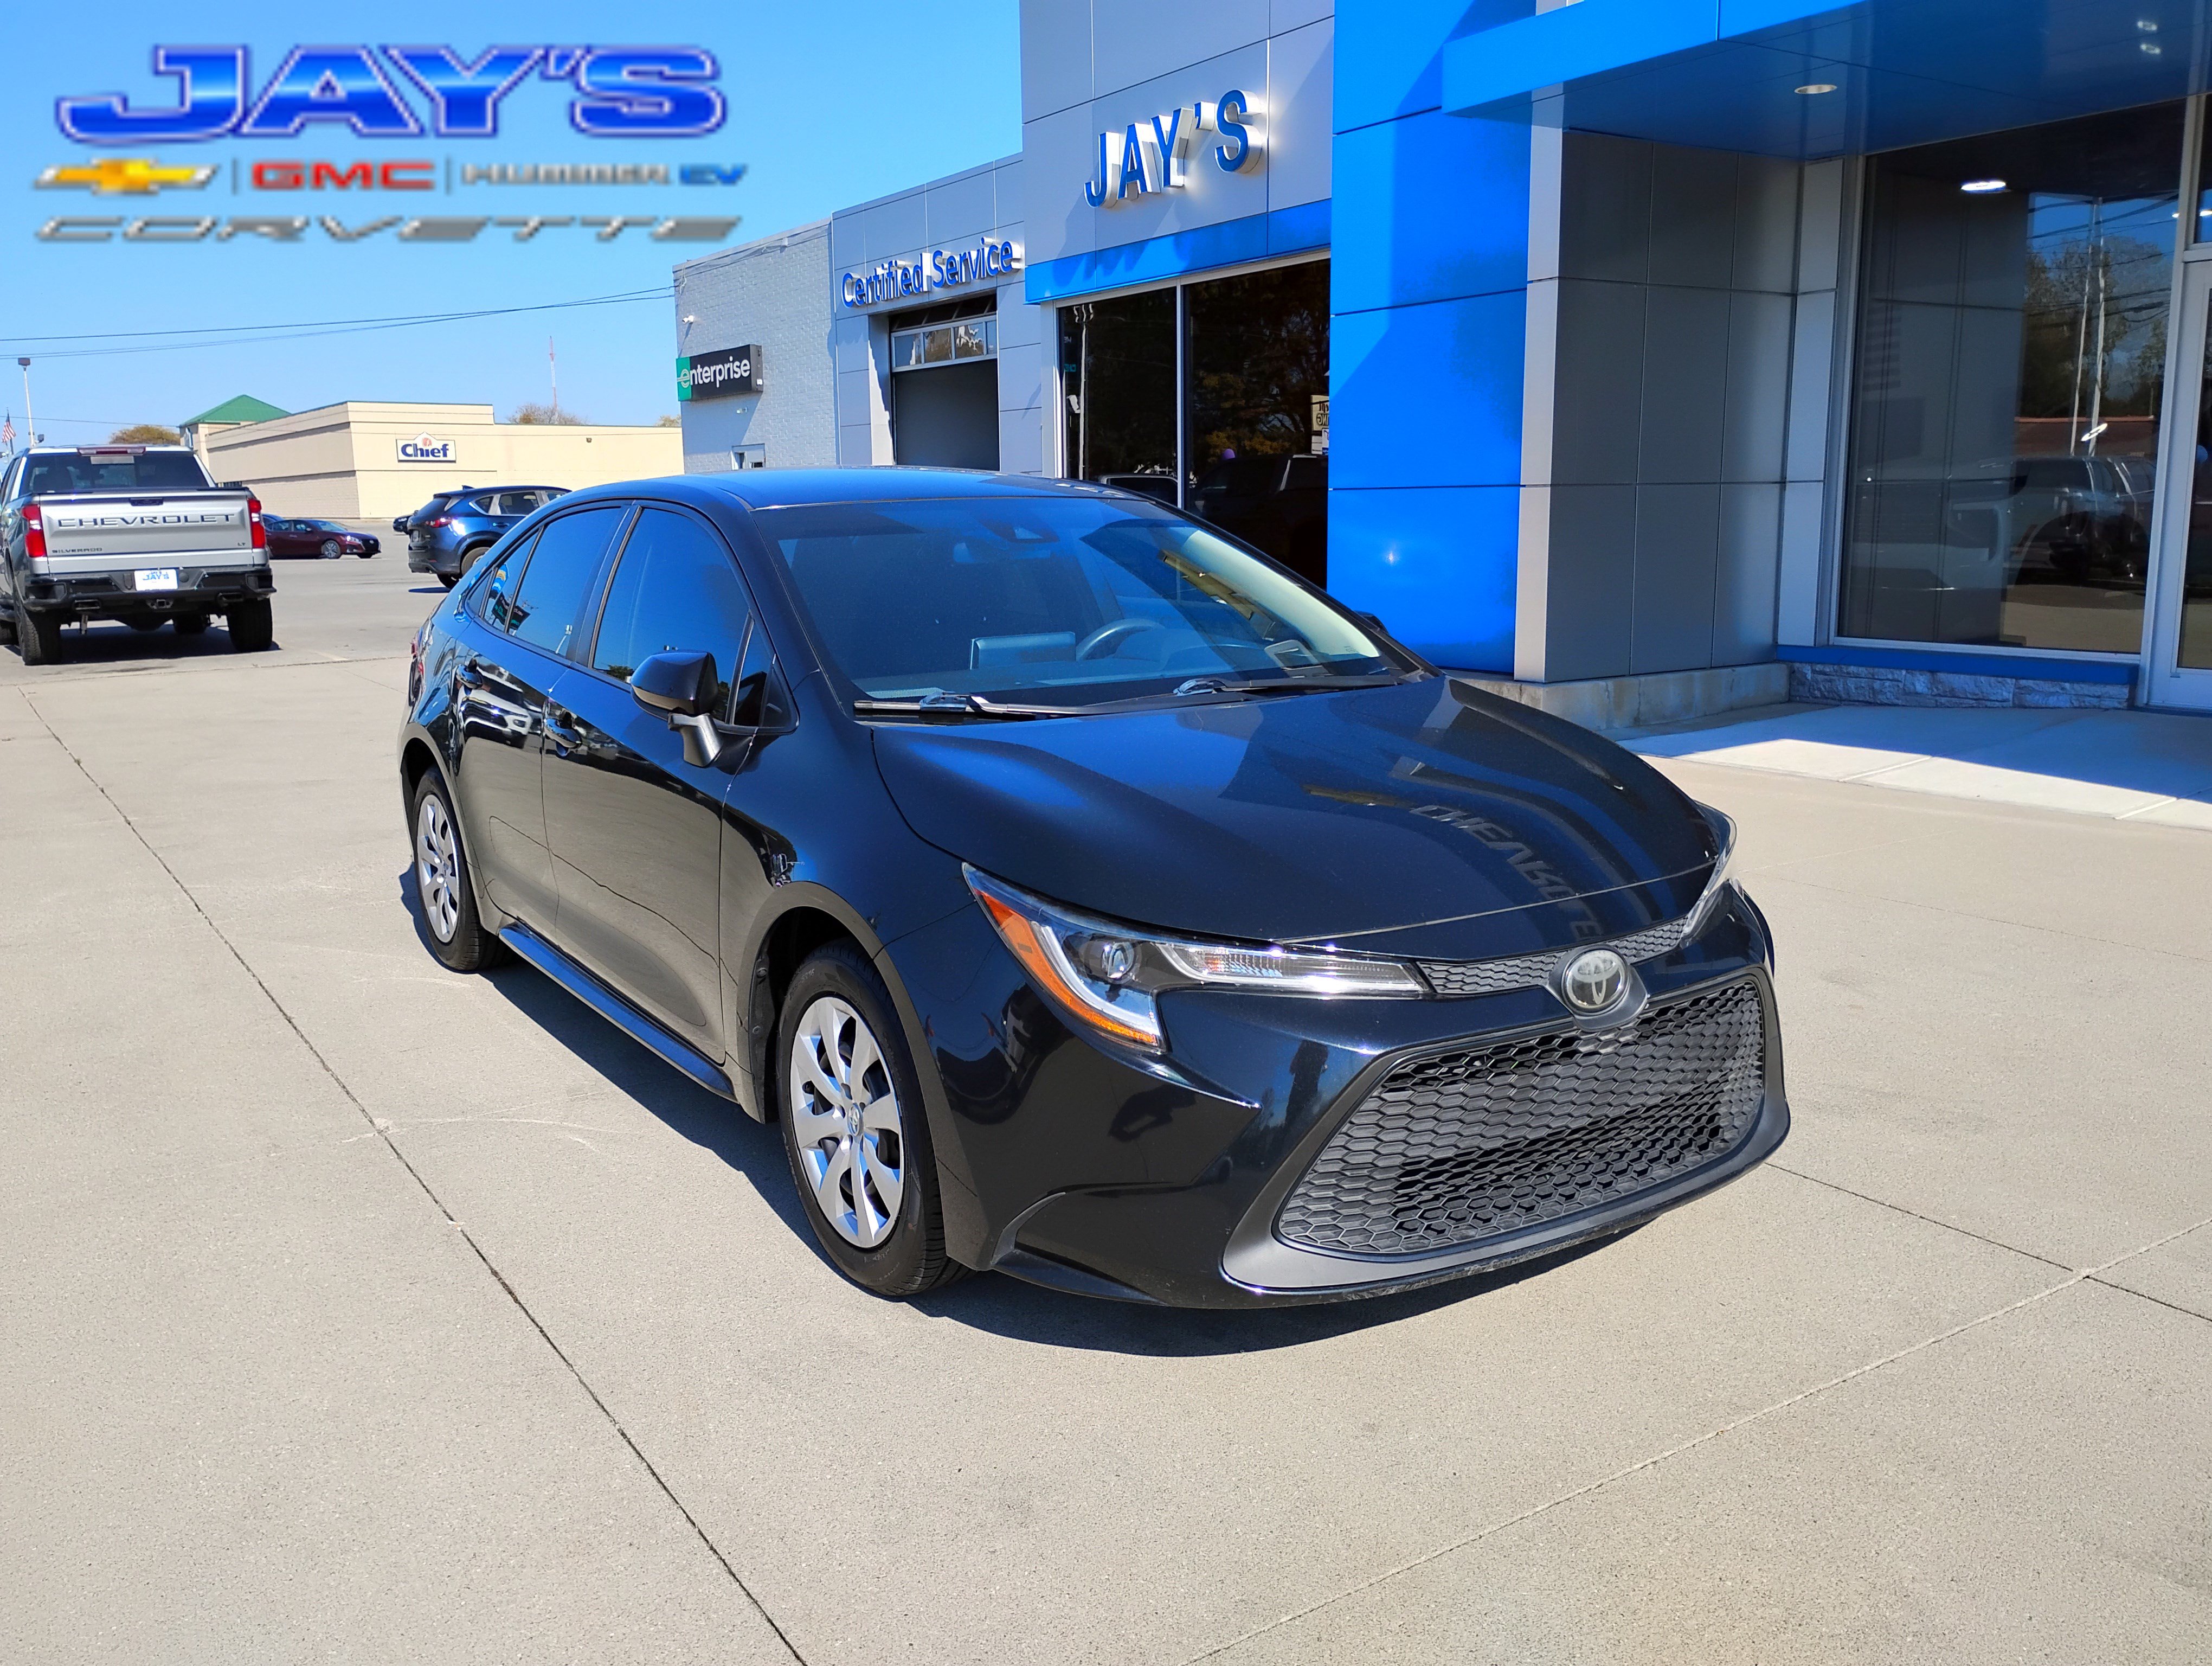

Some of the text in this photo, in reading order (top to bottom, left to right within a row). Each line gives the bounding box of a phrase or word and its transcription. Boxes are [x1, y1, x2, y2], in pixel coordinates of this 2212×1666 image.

[1084, 89, 1259, 208] JAY'S
[842, 237, 1019, 307] Certified Service
[677, 356, 750, 388] enterprise
[401, 443, 449, 457] Chief
[58, 514, 234, 528] CHEVROLET
